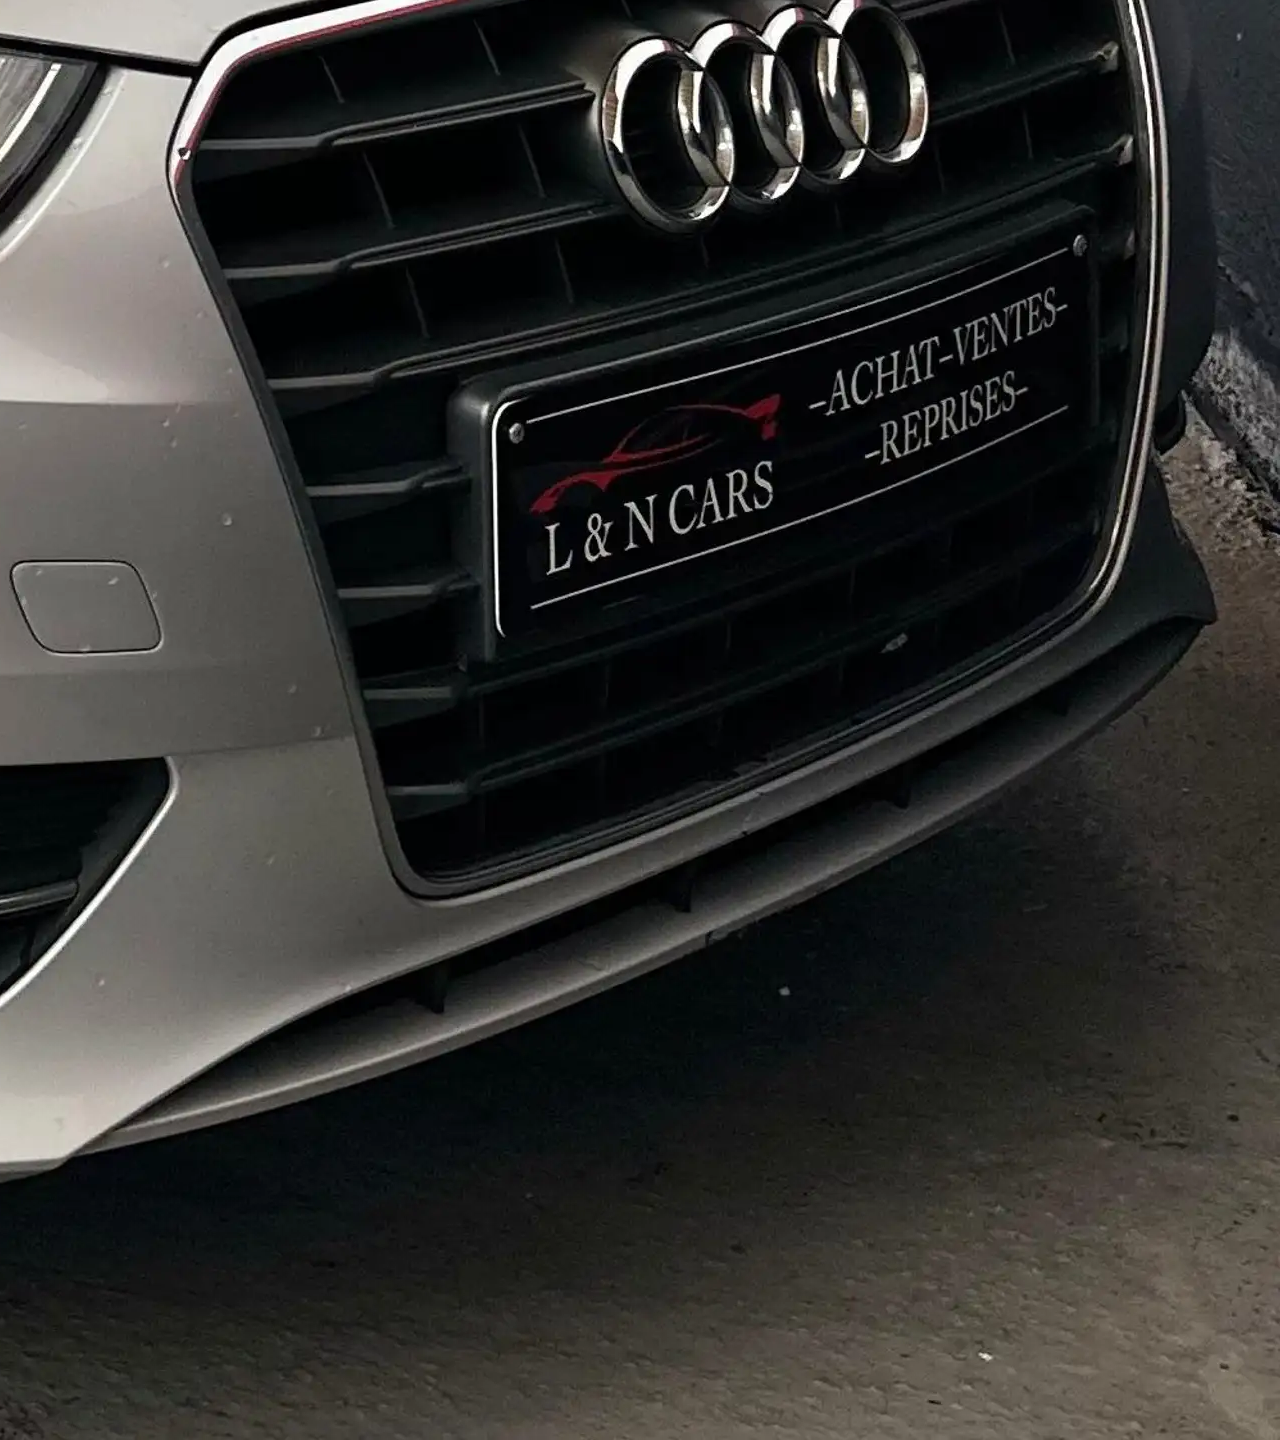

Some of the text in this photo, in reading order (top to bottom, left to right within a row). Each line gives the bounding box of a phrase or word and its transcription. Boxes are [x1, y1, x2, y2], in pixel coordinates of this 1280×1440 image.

[864, 370, 1029, 465] -REPRISES-
[544, 460, 775, 576] L & N CARS
